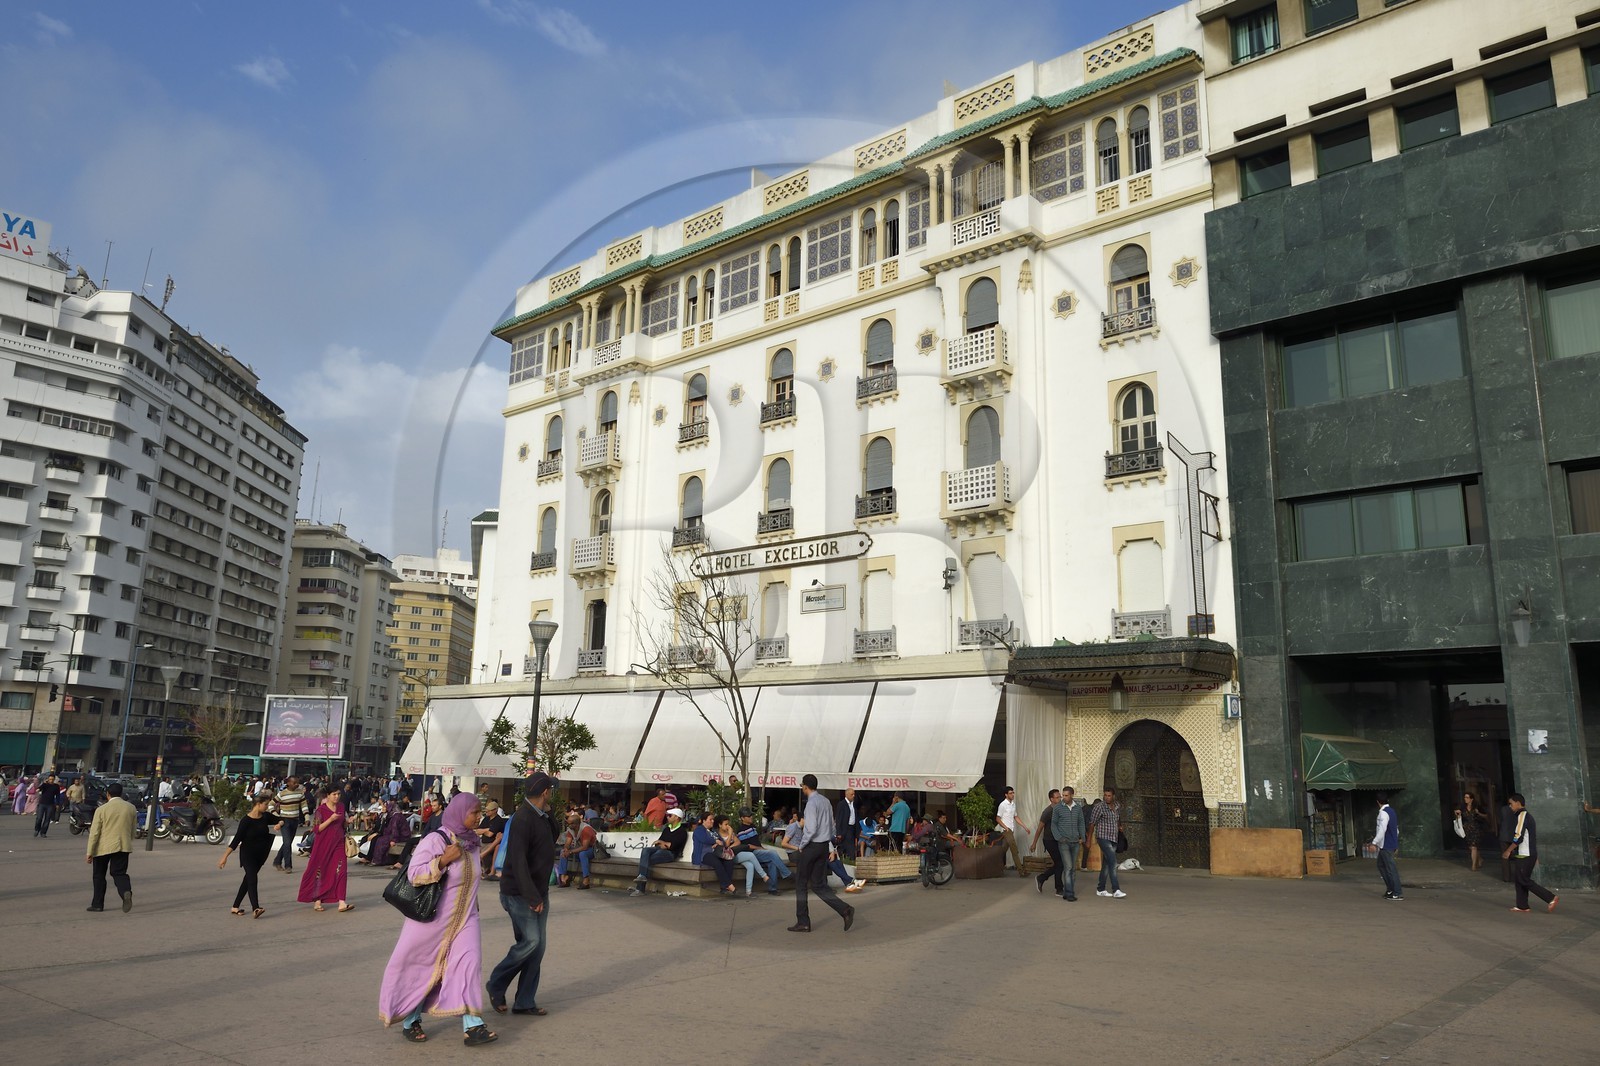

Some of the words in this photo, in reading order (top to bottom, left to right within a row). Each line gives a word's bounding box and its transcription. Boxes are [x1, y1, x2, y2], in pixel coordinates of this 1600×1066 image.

[715, 552, 755, 571] HOTEL
[765, 541, 840, 564] EXCELSIOR
[1072, 686, 1107, 695] EXPOSITION
[440, 766, 455, 775] CAFE
[473, 767, 498, 776] GLACIER
[848, 777, 909, 789] EXCELSIOR
